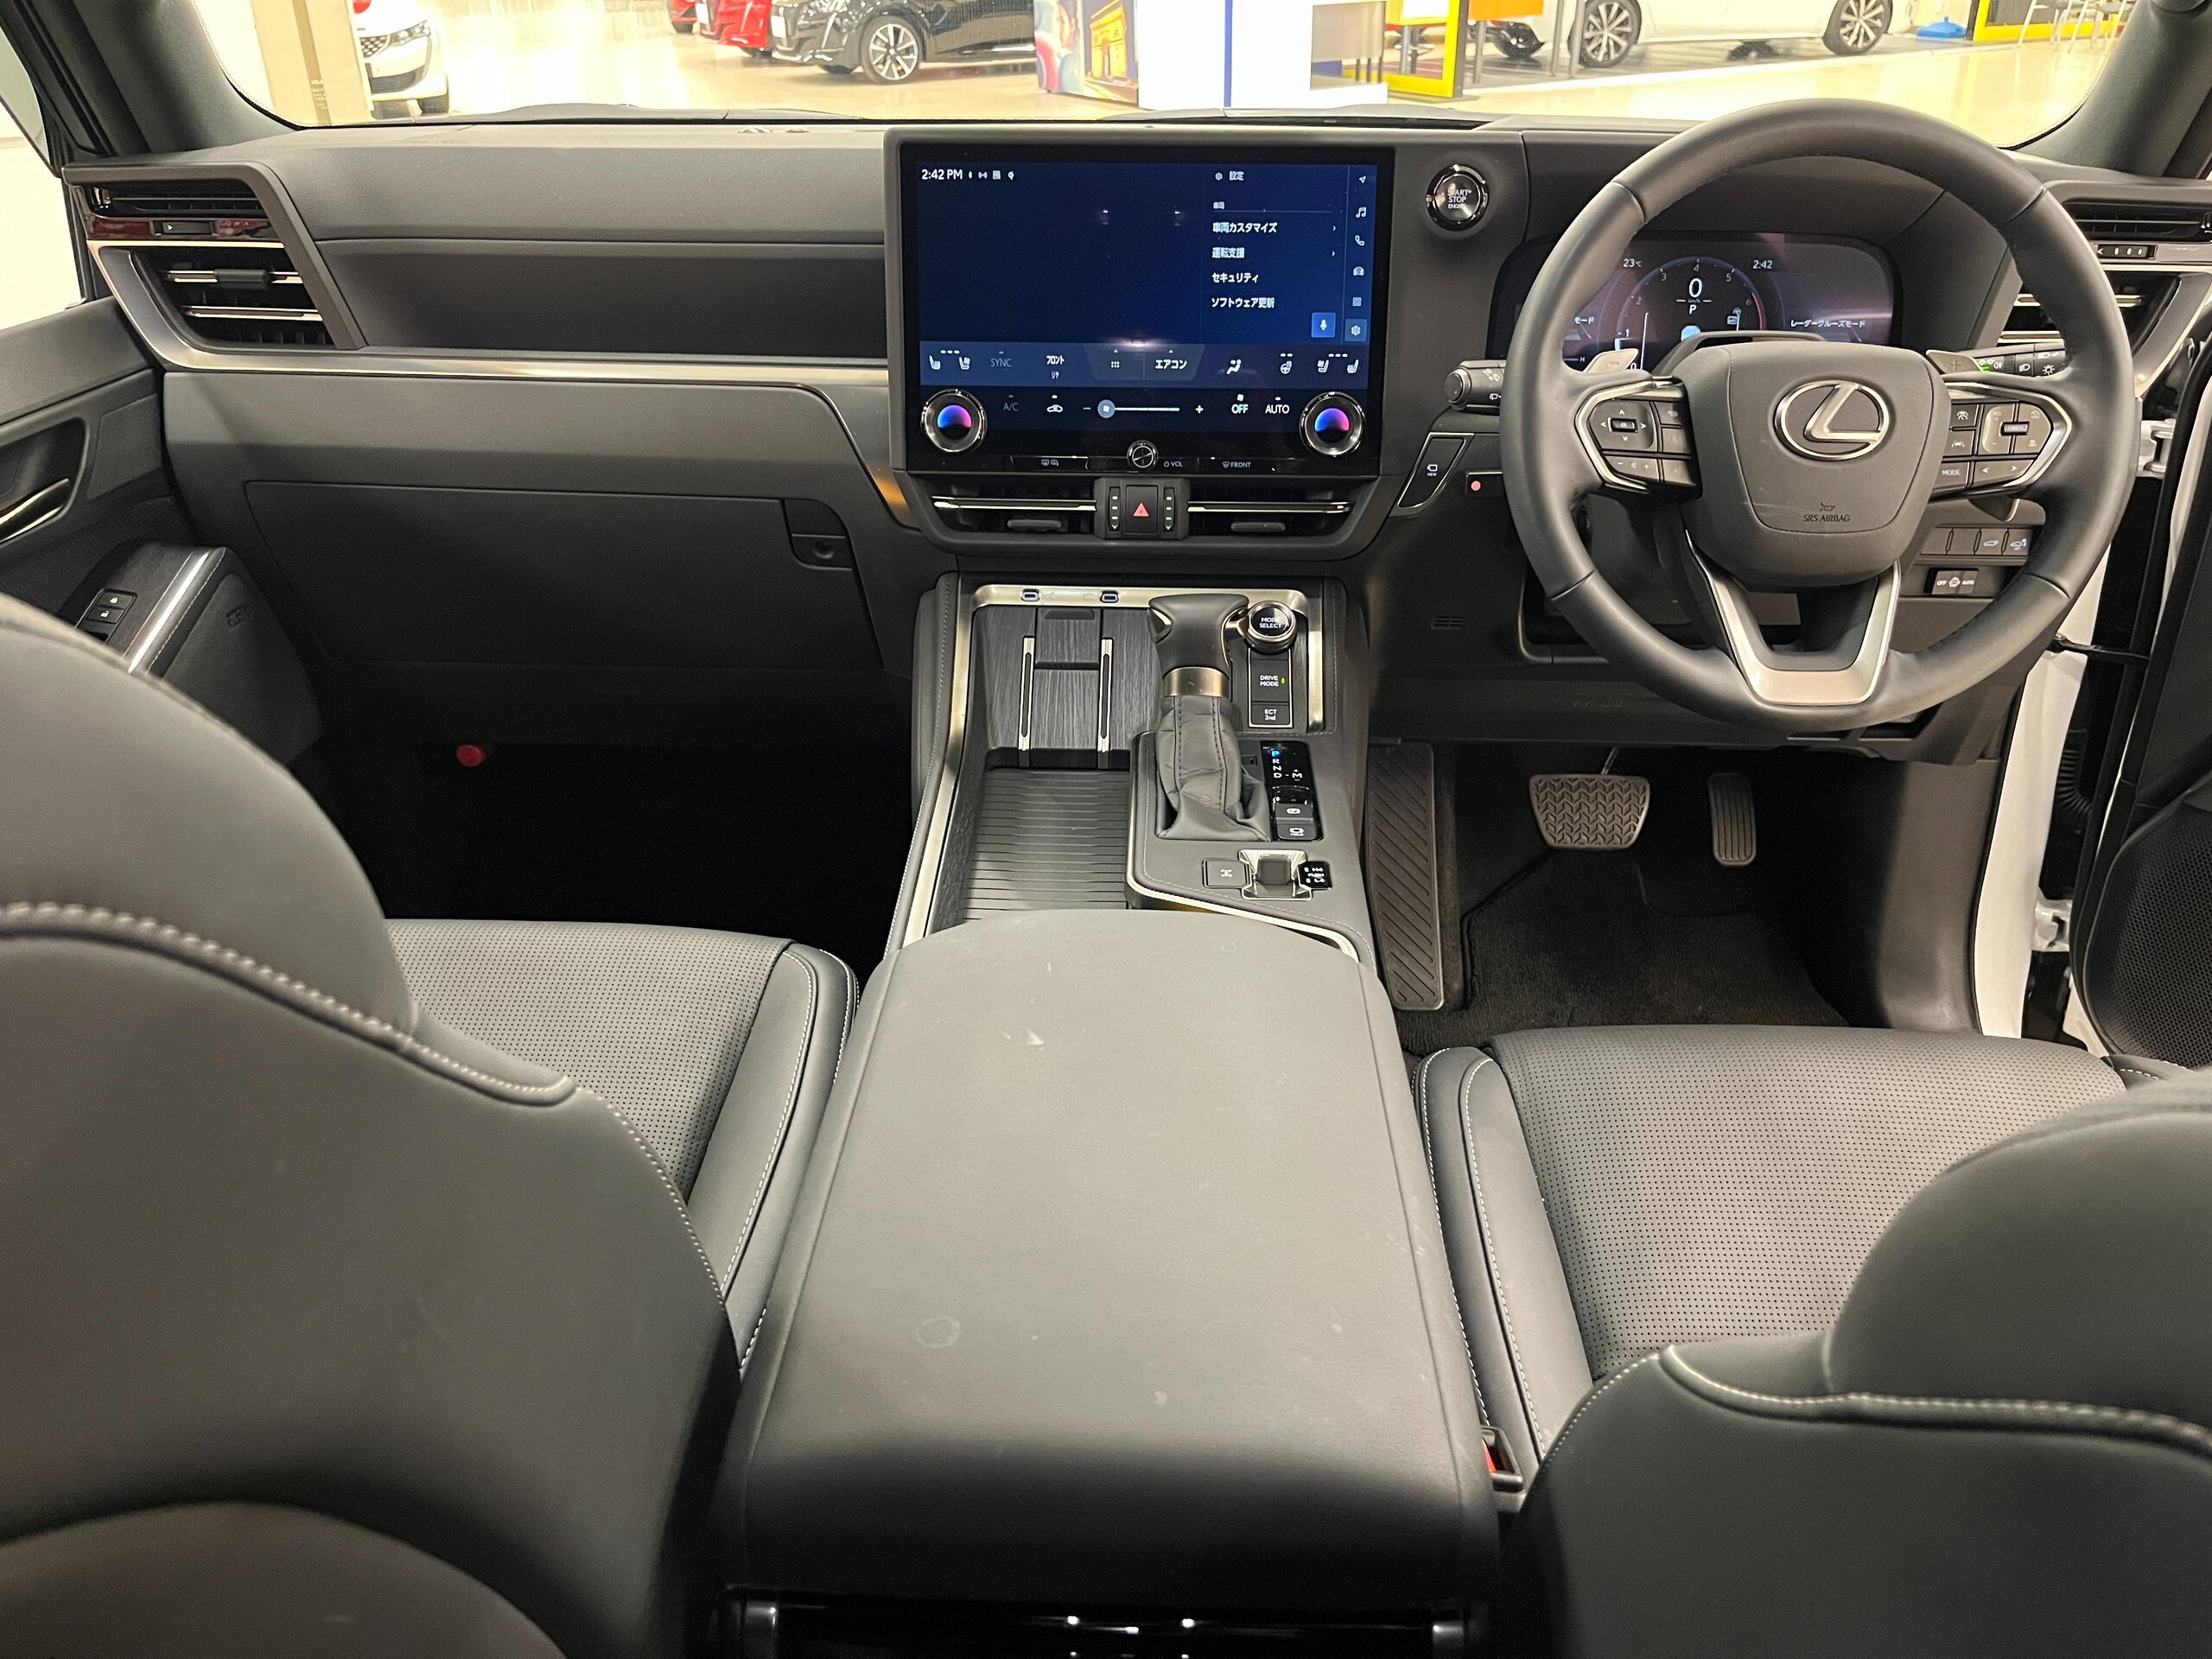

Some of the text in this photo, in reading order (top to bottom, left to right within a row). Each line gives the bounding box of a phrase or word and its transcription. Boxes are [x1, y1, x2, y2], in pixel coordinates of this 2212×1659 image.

[921, 169, 963, 180] 2:42 PM
[1212, 222, 1277, 233] 車両カスタマイズ
[1693, 264, 1700, 272] 4
[1752, 260, 1773, 269] 2:42
[1211, 272, 1259, 283] セキュリティ
[1661, 273, 1667, 282] 3
[1726, 273, 1732, 283] 5
[1688, 277, 1702, 298] 0
[1211, 297, 1274, 308] ソフトウェア更新
[1636, 296, 1642, 305] 2
[1689, 304, 1697, 315] P
[1790, 320, 1866, 328] レーダークルーズモード
[990, 359, 1012, 367] SYNC
[1046, 355, 1065, 365] フロント
[1154, 359, 1187, 369] エアコン
[1003, 403, 1018, 411] A/C
[1231, 404, 1249, 414] OFF
[1265, 404, 1290, 414] AUTO
[1802, 514, 1851, 523] SRS AIRBAG
